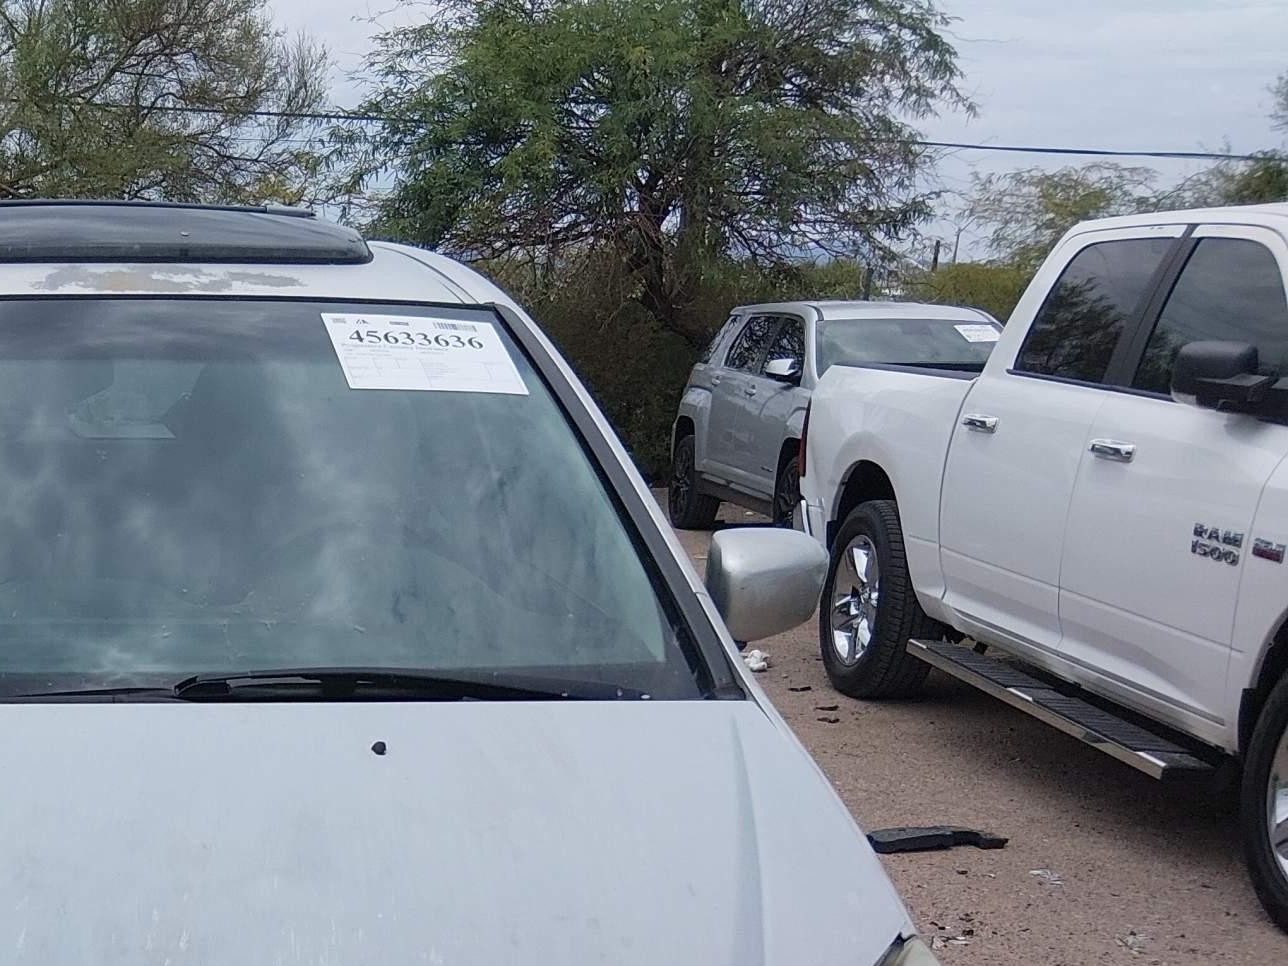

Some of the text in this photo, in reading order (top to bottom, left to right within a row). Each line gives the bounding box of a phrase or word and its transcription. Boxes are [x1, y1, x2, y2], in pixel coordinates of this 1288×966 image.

[350, 330, 484, 349] 45633636
[1193, 523, 1244, 548] RAM
[1191, 540, 1239, 566] 1500
